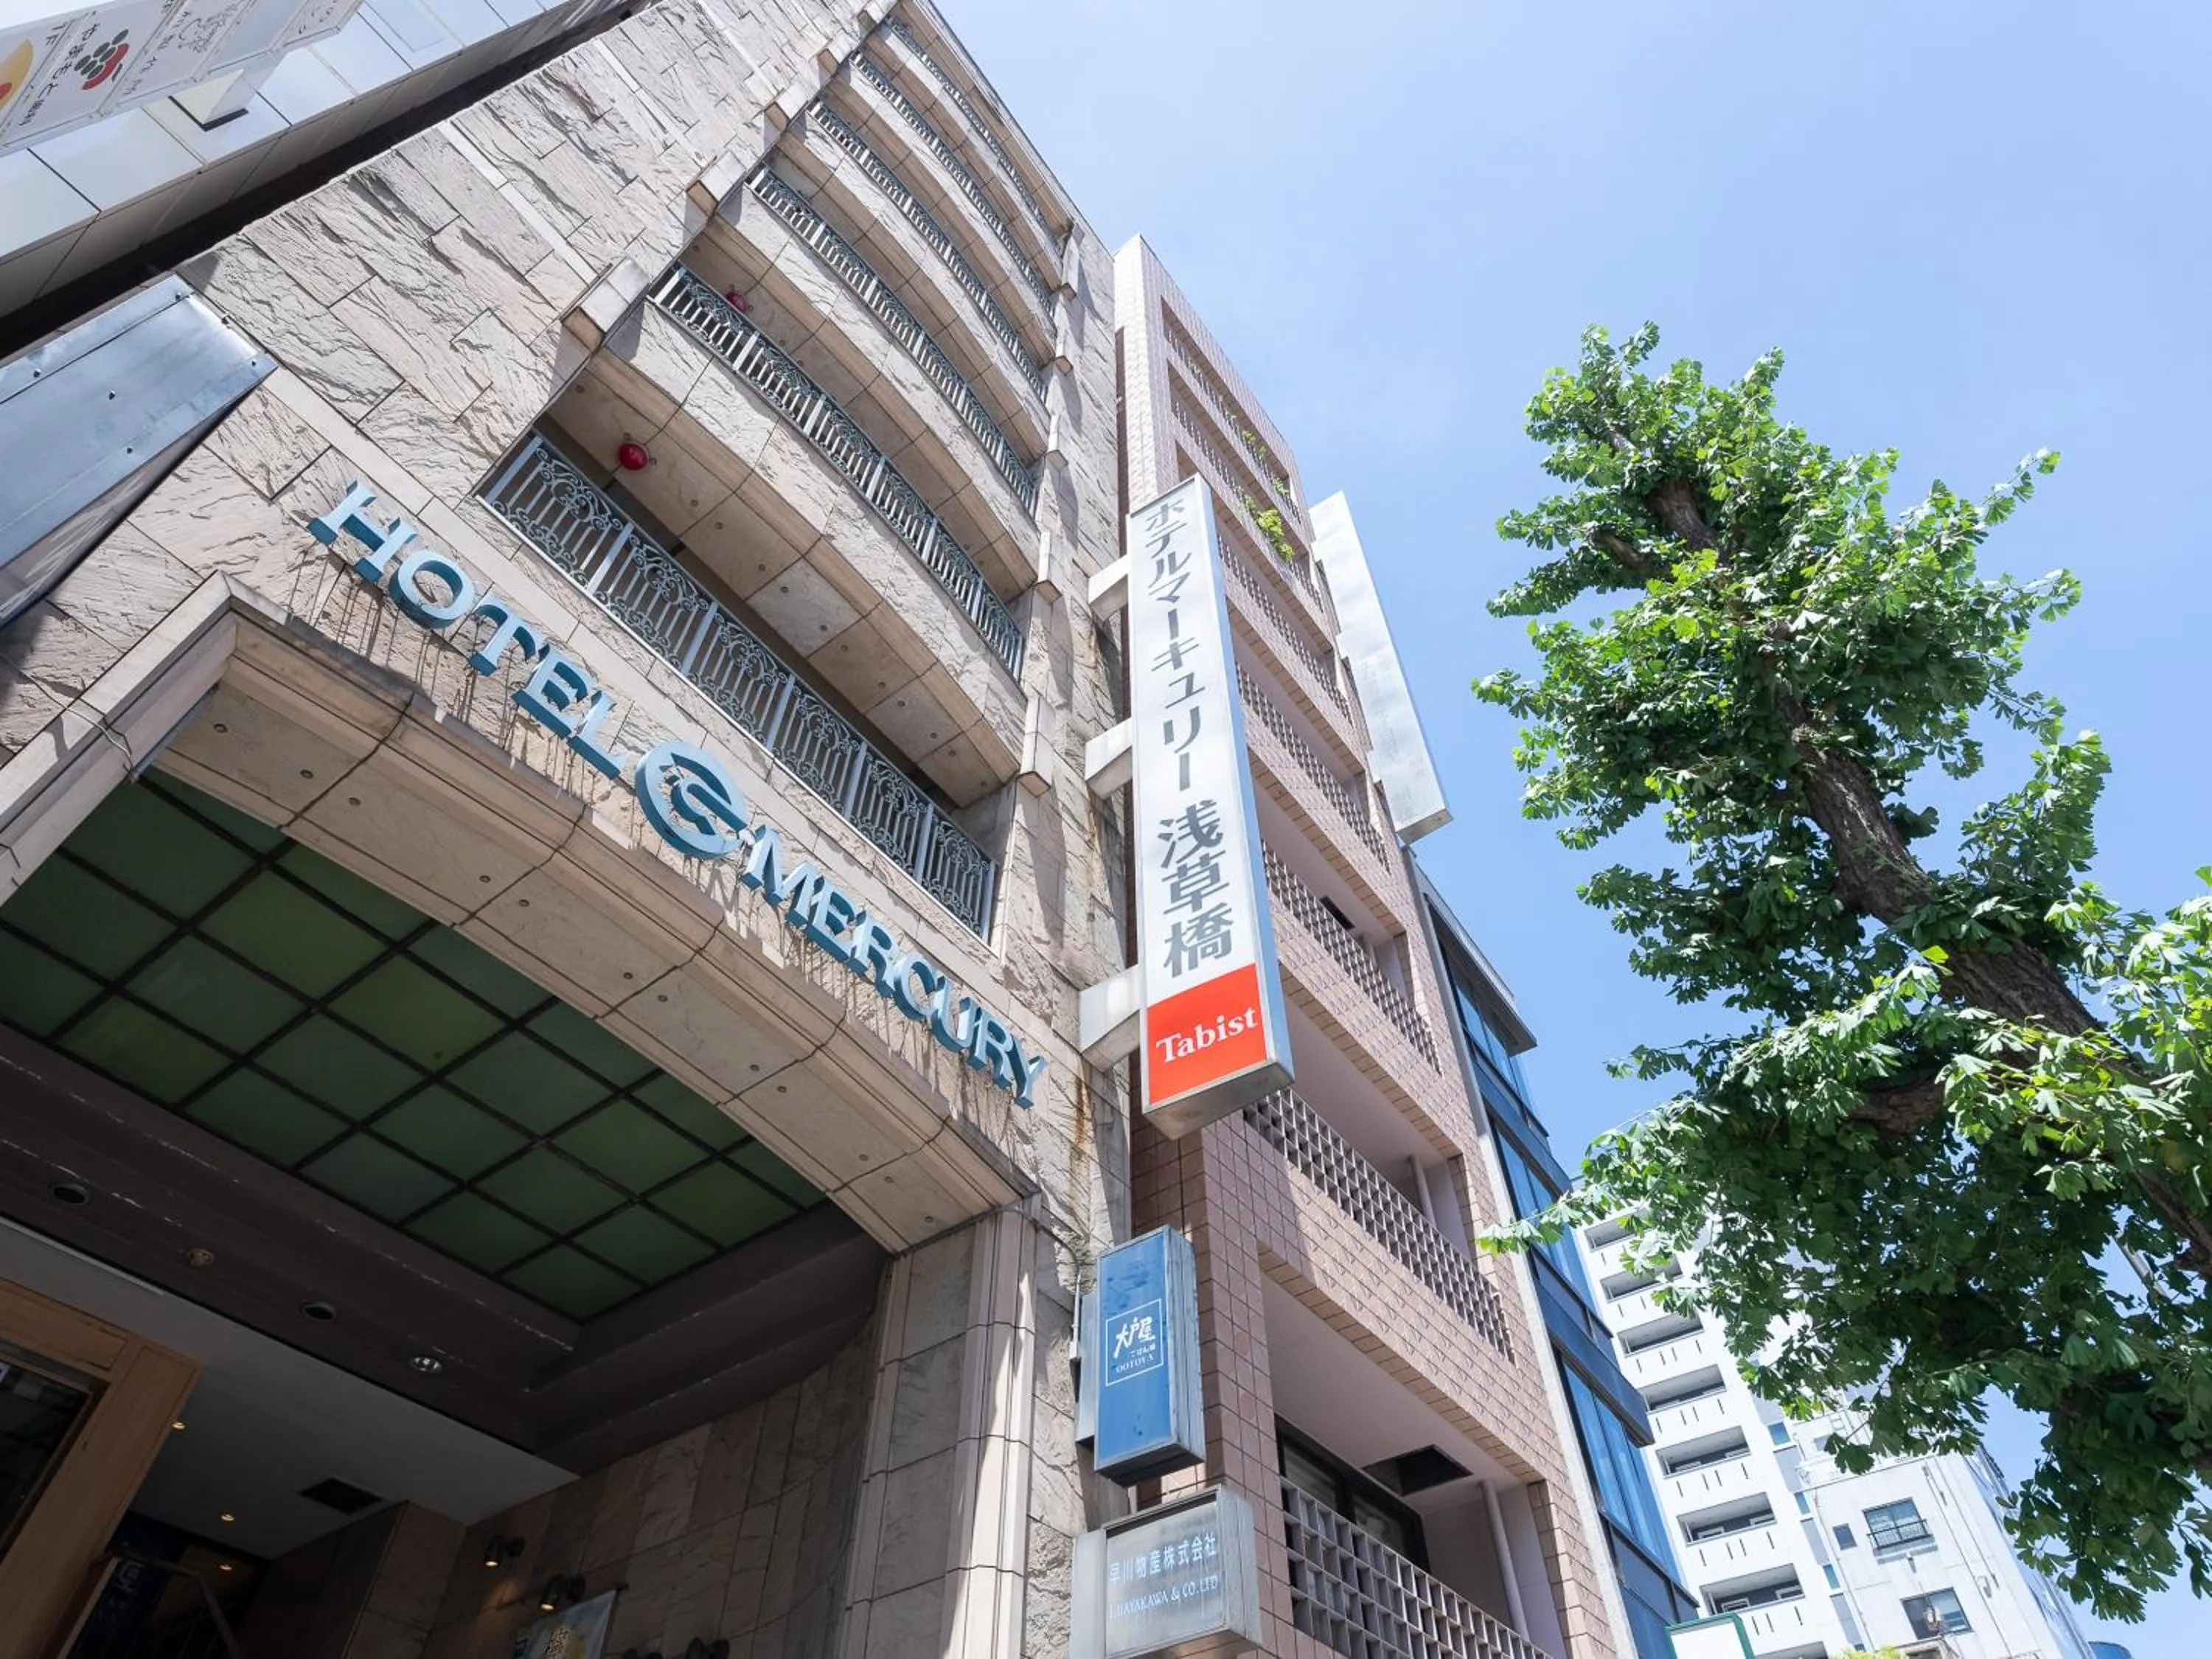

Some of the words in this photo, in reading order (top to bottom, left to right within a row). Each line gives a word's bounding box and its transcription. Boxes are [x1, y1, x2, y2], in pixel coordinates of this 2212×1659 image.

[306, 477, 629, 779] HOTEL
[739, 825, 1047, 1109] MERCURY
[1156, 1006, 1258, 1062] Tabist
[1114, 1316, 1156, 1359] 大戸屋
